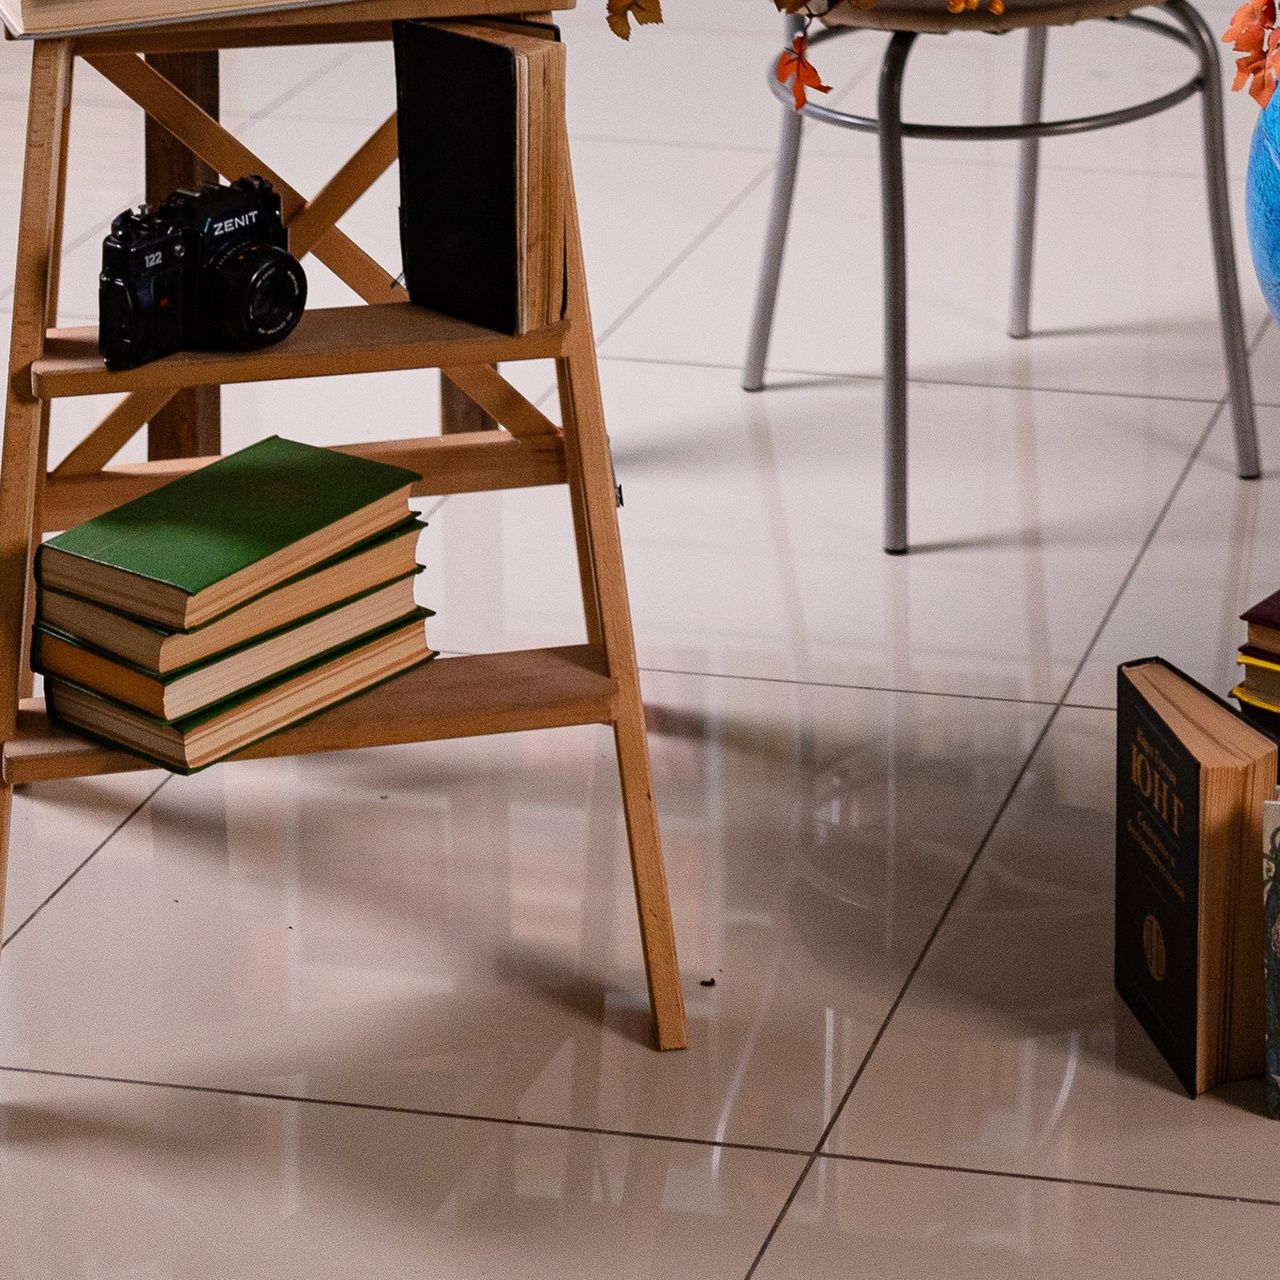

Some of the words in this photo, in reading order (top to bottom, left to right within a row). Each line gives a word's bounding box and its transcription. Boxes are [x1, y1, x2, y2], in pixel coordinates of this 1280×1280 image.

[213, 211, 258, 236] ZENIT
[144, 251, 162, 268] 122
[1131, 743, 1184, 838] ЮНГ
